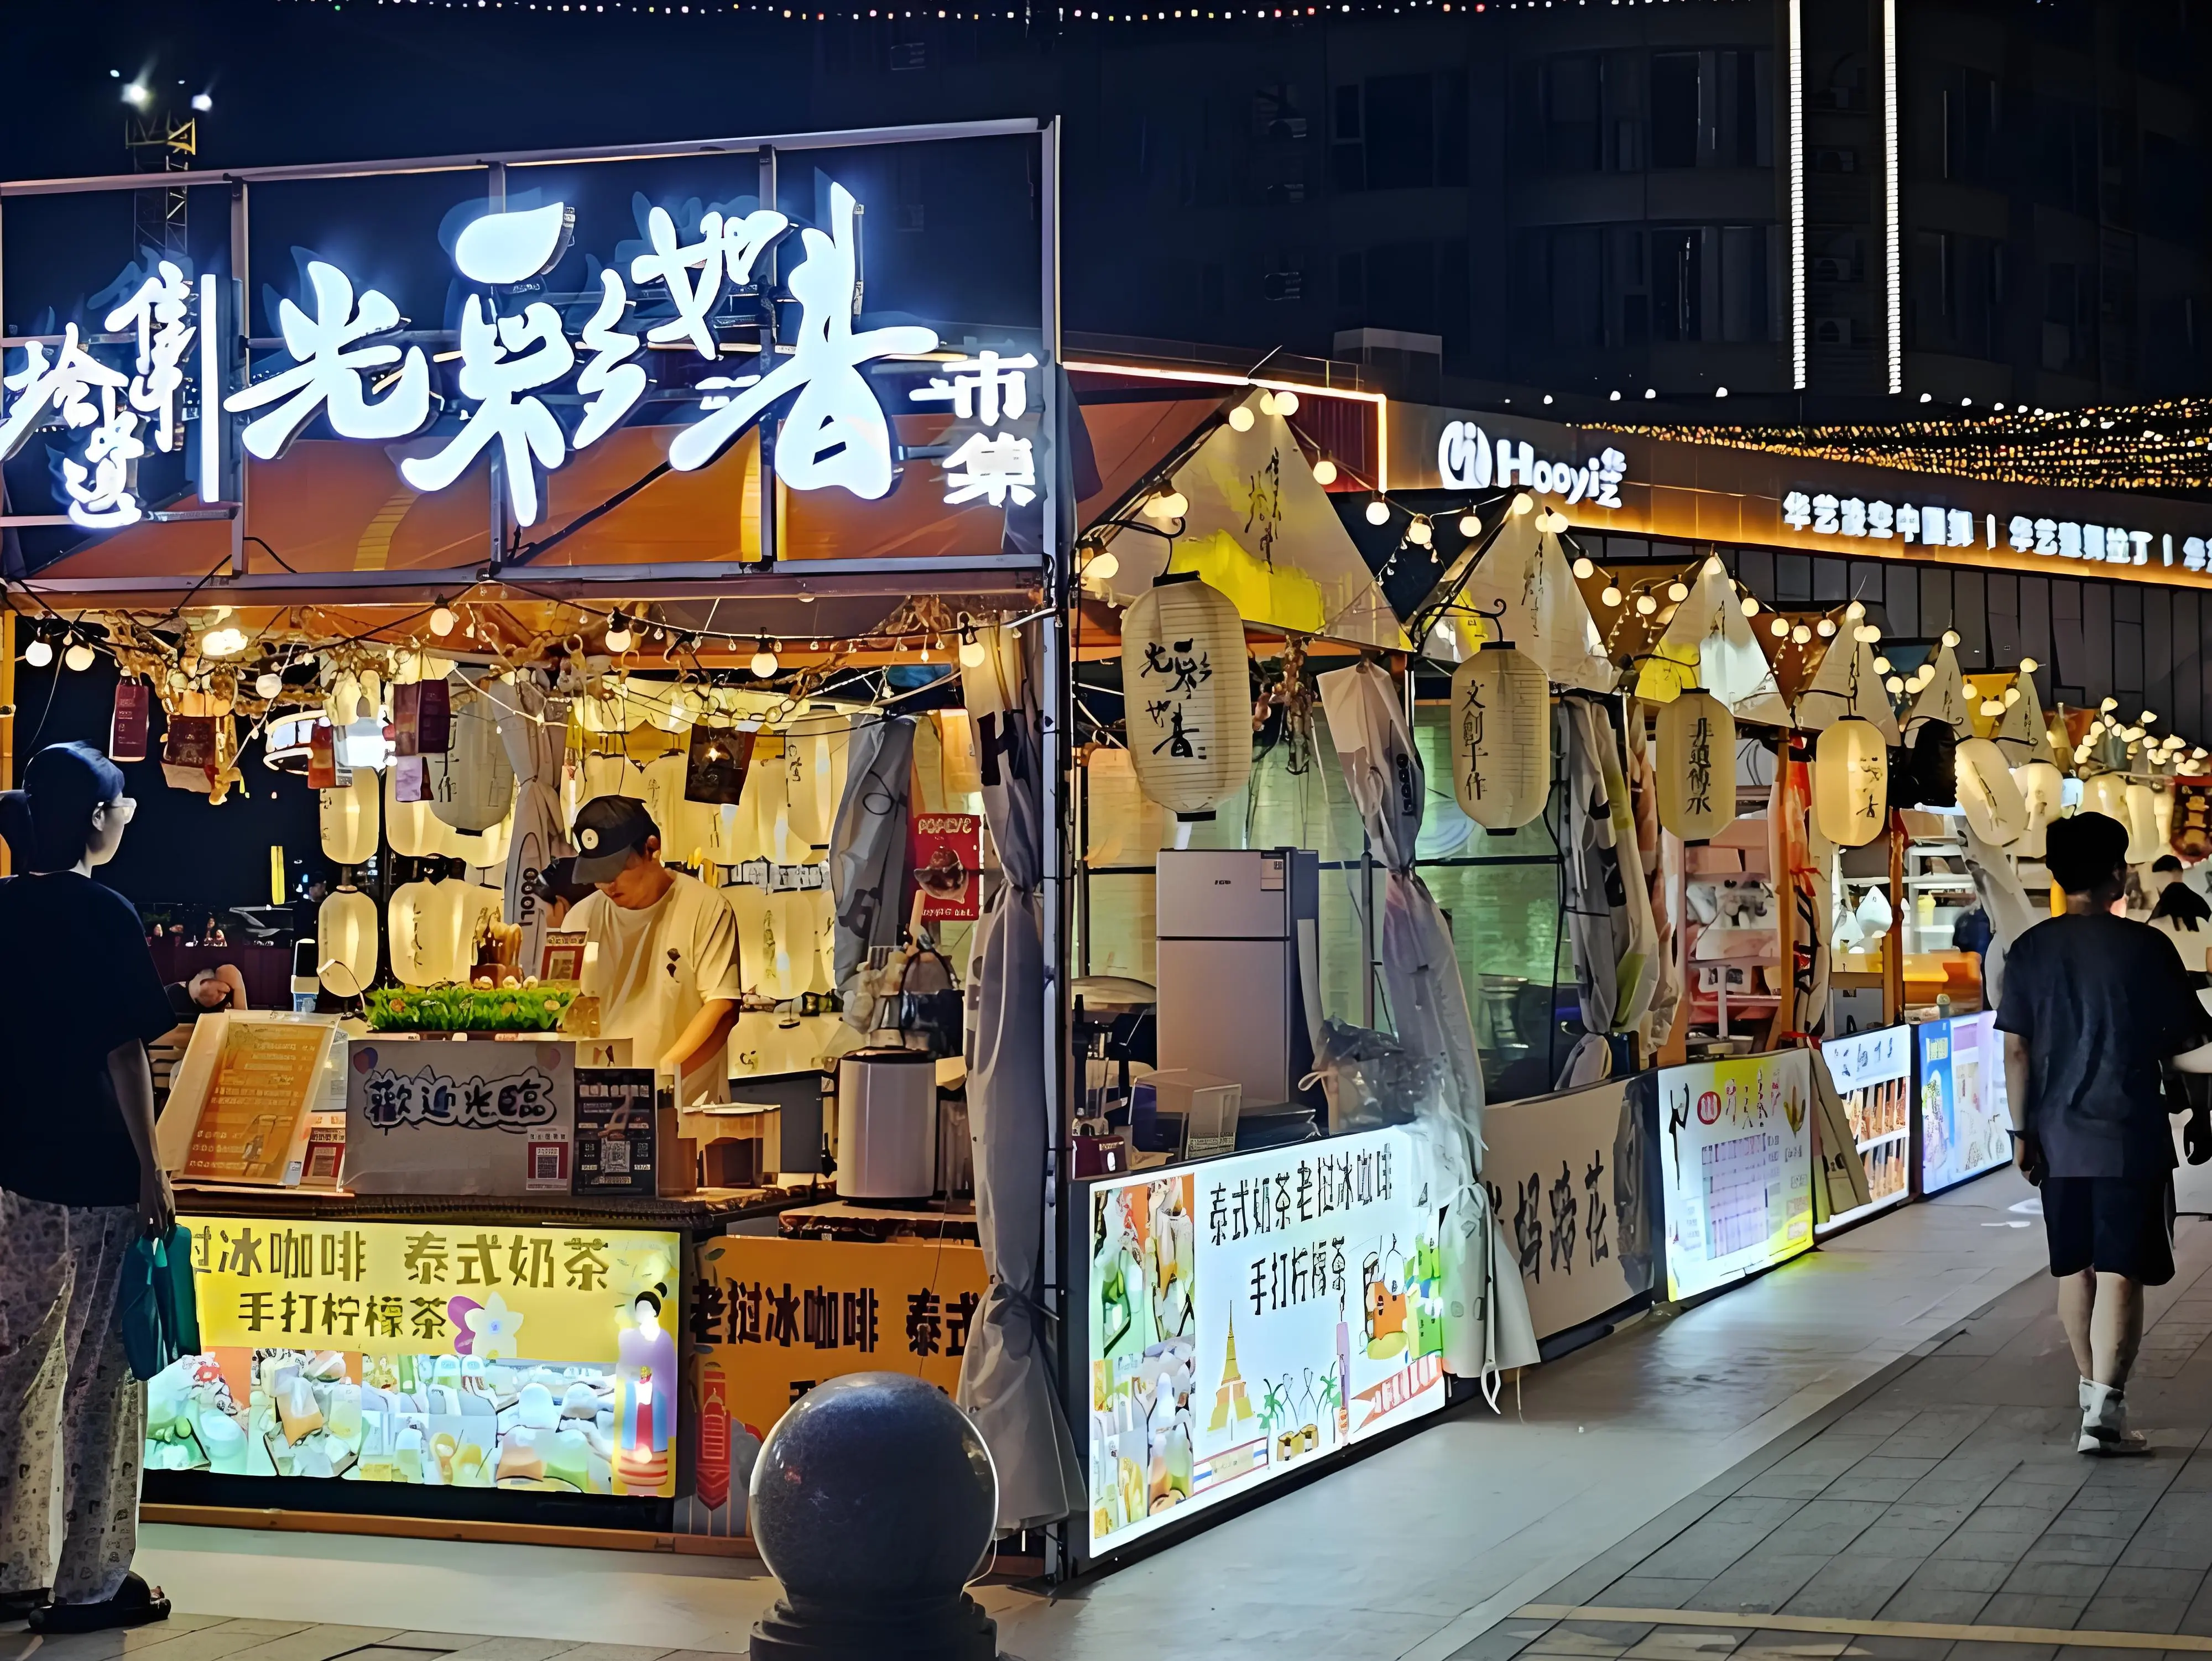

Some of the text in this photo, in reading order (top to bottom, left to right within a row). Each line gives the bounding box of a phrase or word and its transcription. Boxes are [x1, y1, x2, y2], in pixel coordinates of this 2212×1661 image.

[1496, 439, 1599, 504] Hooyi
[403, 1230, 610, 1291] 泰式奶茶
[238, 1291, 448, 1340] 手打柠檬茶
[690, 1277, 879, 1353] 老挝冰咖啡
